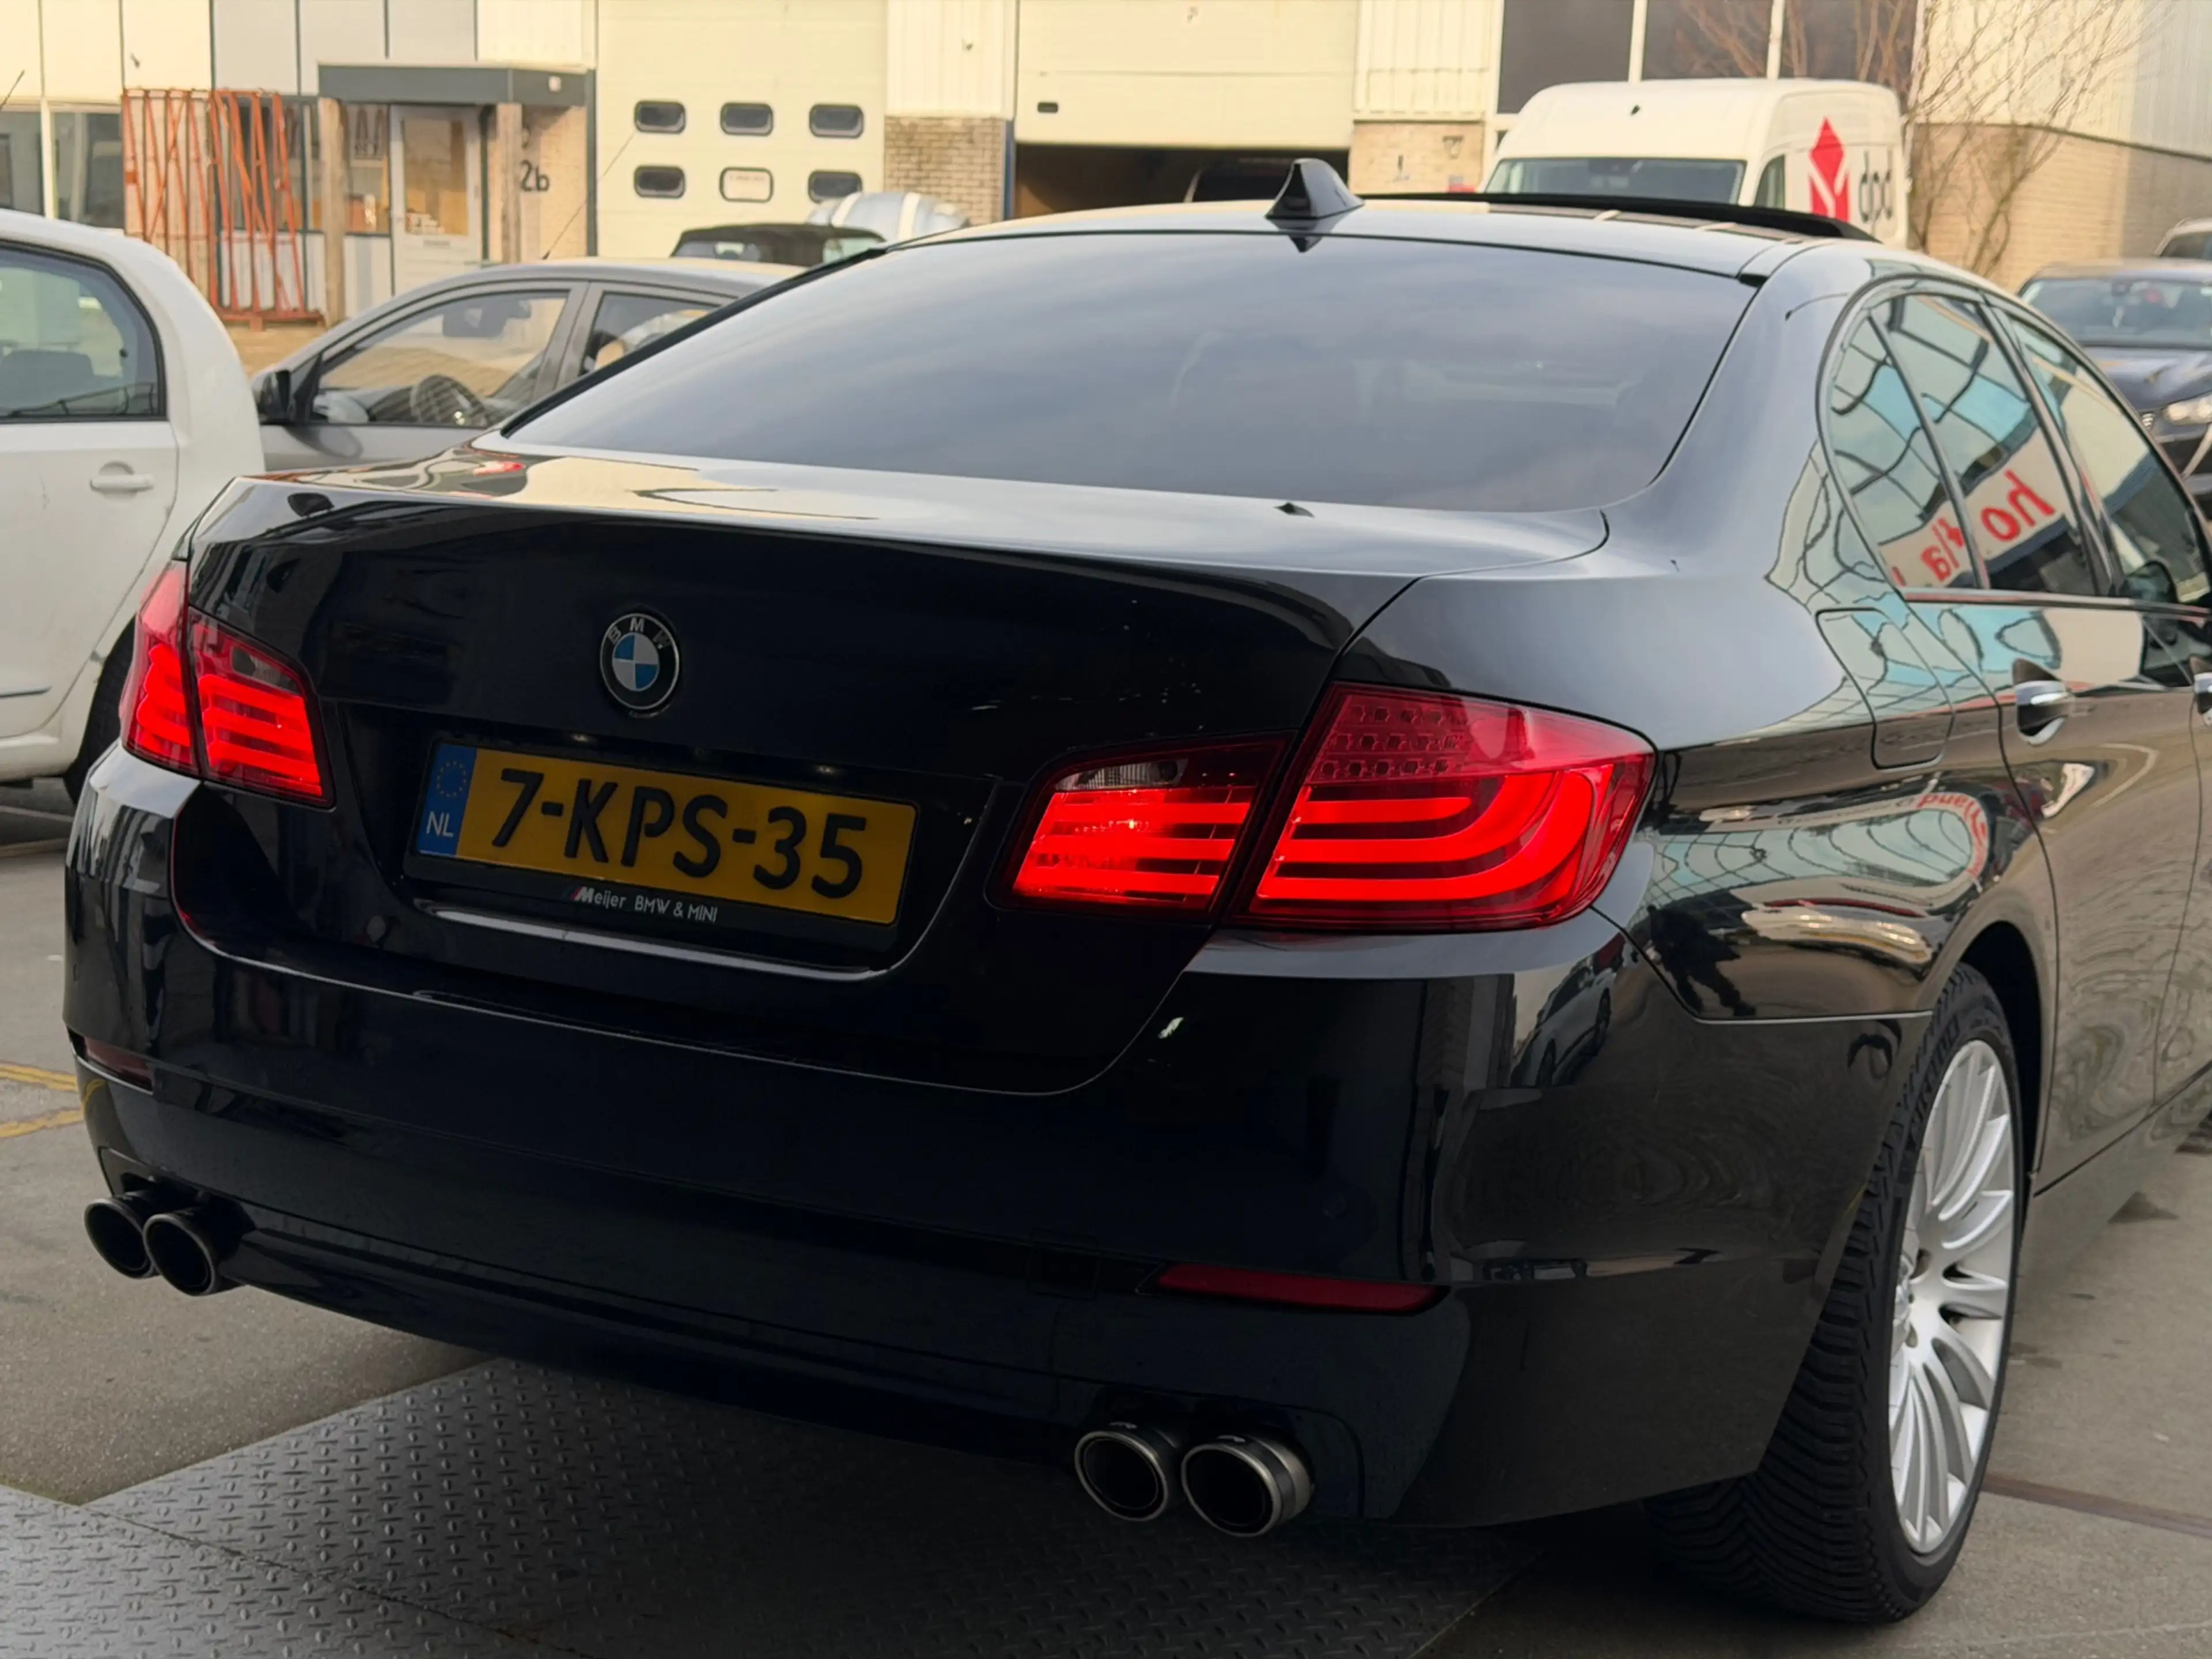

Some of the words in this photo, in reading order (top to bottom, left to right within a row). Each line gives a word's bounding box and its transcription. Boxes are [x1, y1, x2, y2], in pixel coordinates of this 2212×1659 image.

[520, 160, 550, 192] 2b
[1858, 150, 1893, 237] dpd
[608, 617, 671, 649] BMW
[426, 810, 454, 838] NL
[491, 768, 867, 899] 7-KPS-35
[574, 886, 627, 910] Meijer
[634, 895, 671, 915] BMW
[672, 902, 684, 918] &
[687, 903, 718, 923] MINI
